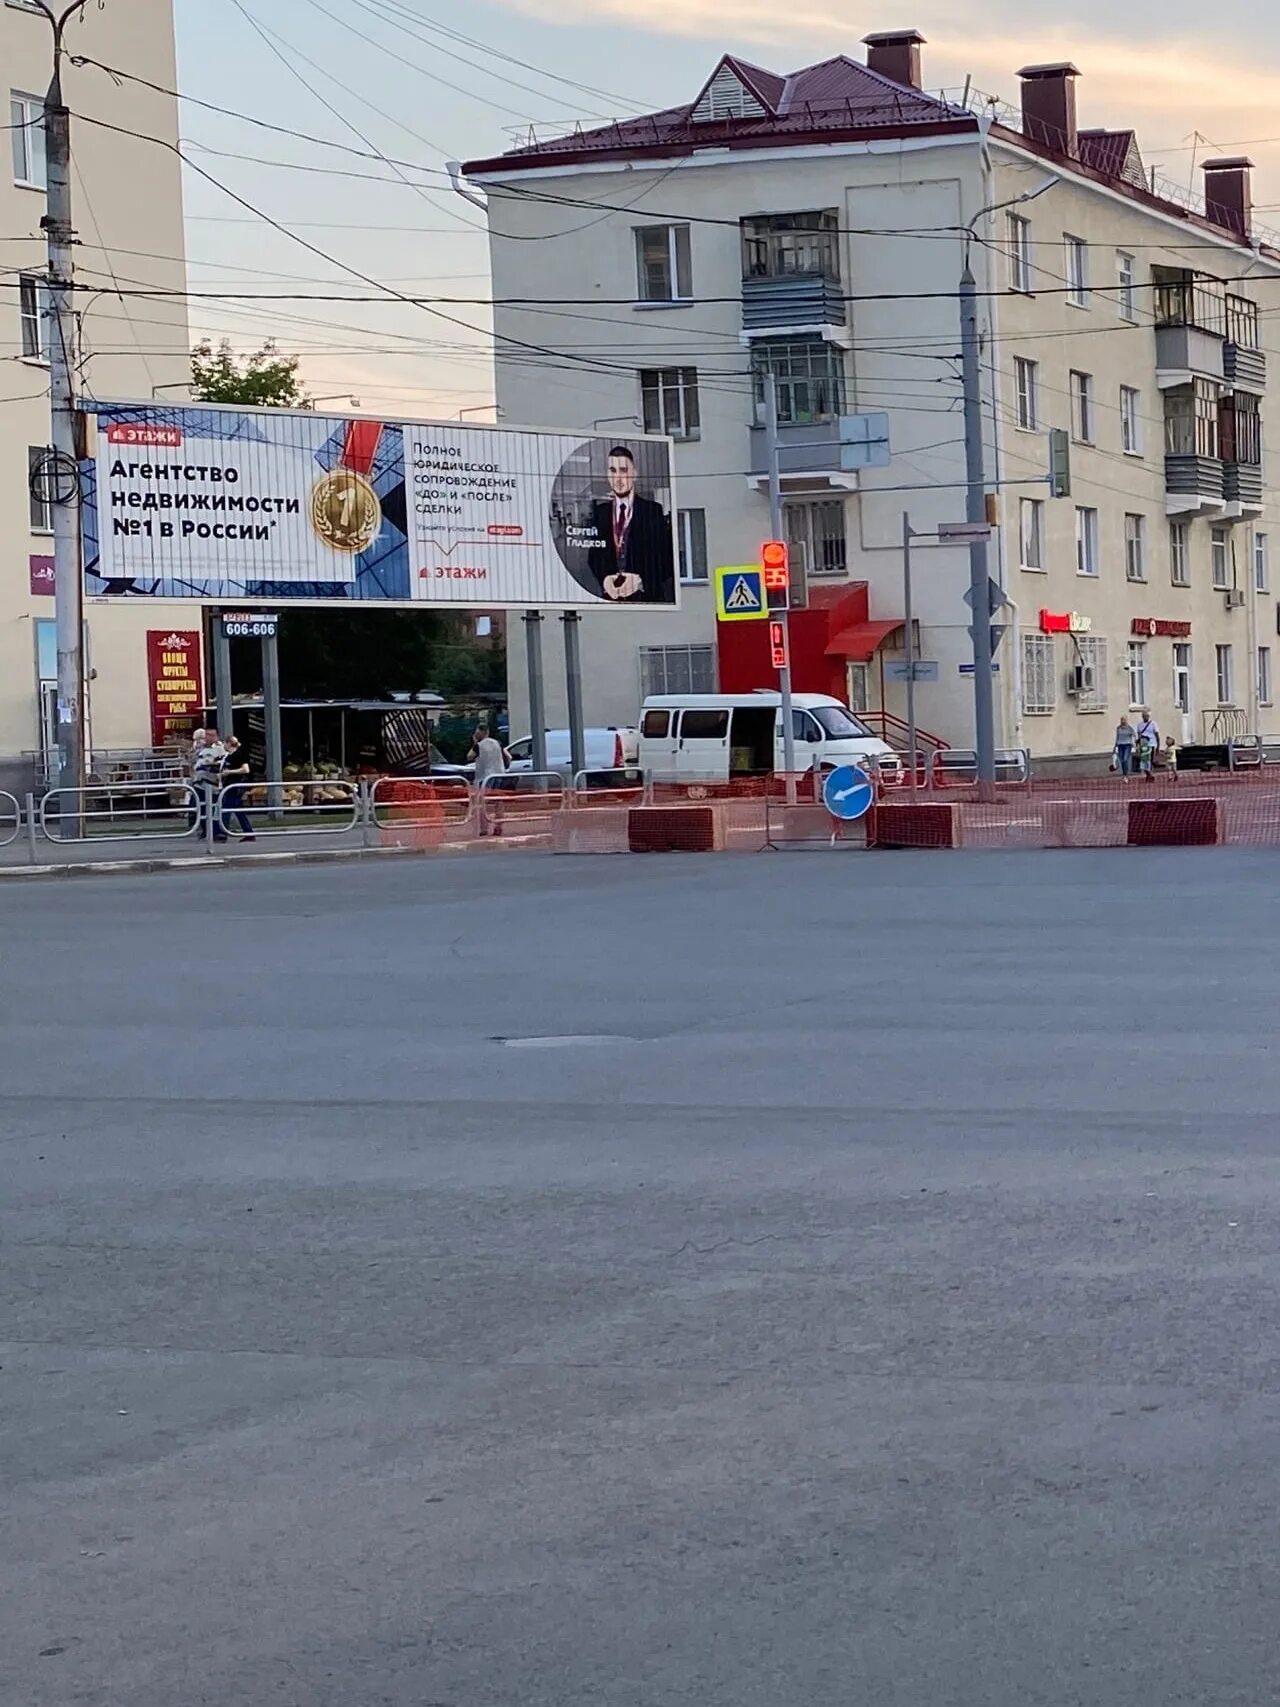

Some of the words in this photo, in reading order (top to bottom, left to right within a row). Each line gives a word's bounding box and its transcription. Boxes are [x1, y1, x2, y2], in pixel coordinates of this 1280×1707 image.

[110, 460, 239, 483] Агентство
[111, 491, 299, 514] недвижимости
[113, 518, 152, 537] №1
[160, 521, 174, 538] в
[435, 567, 487, 579] этажи
[226, 623, 275, 635] 606-606
